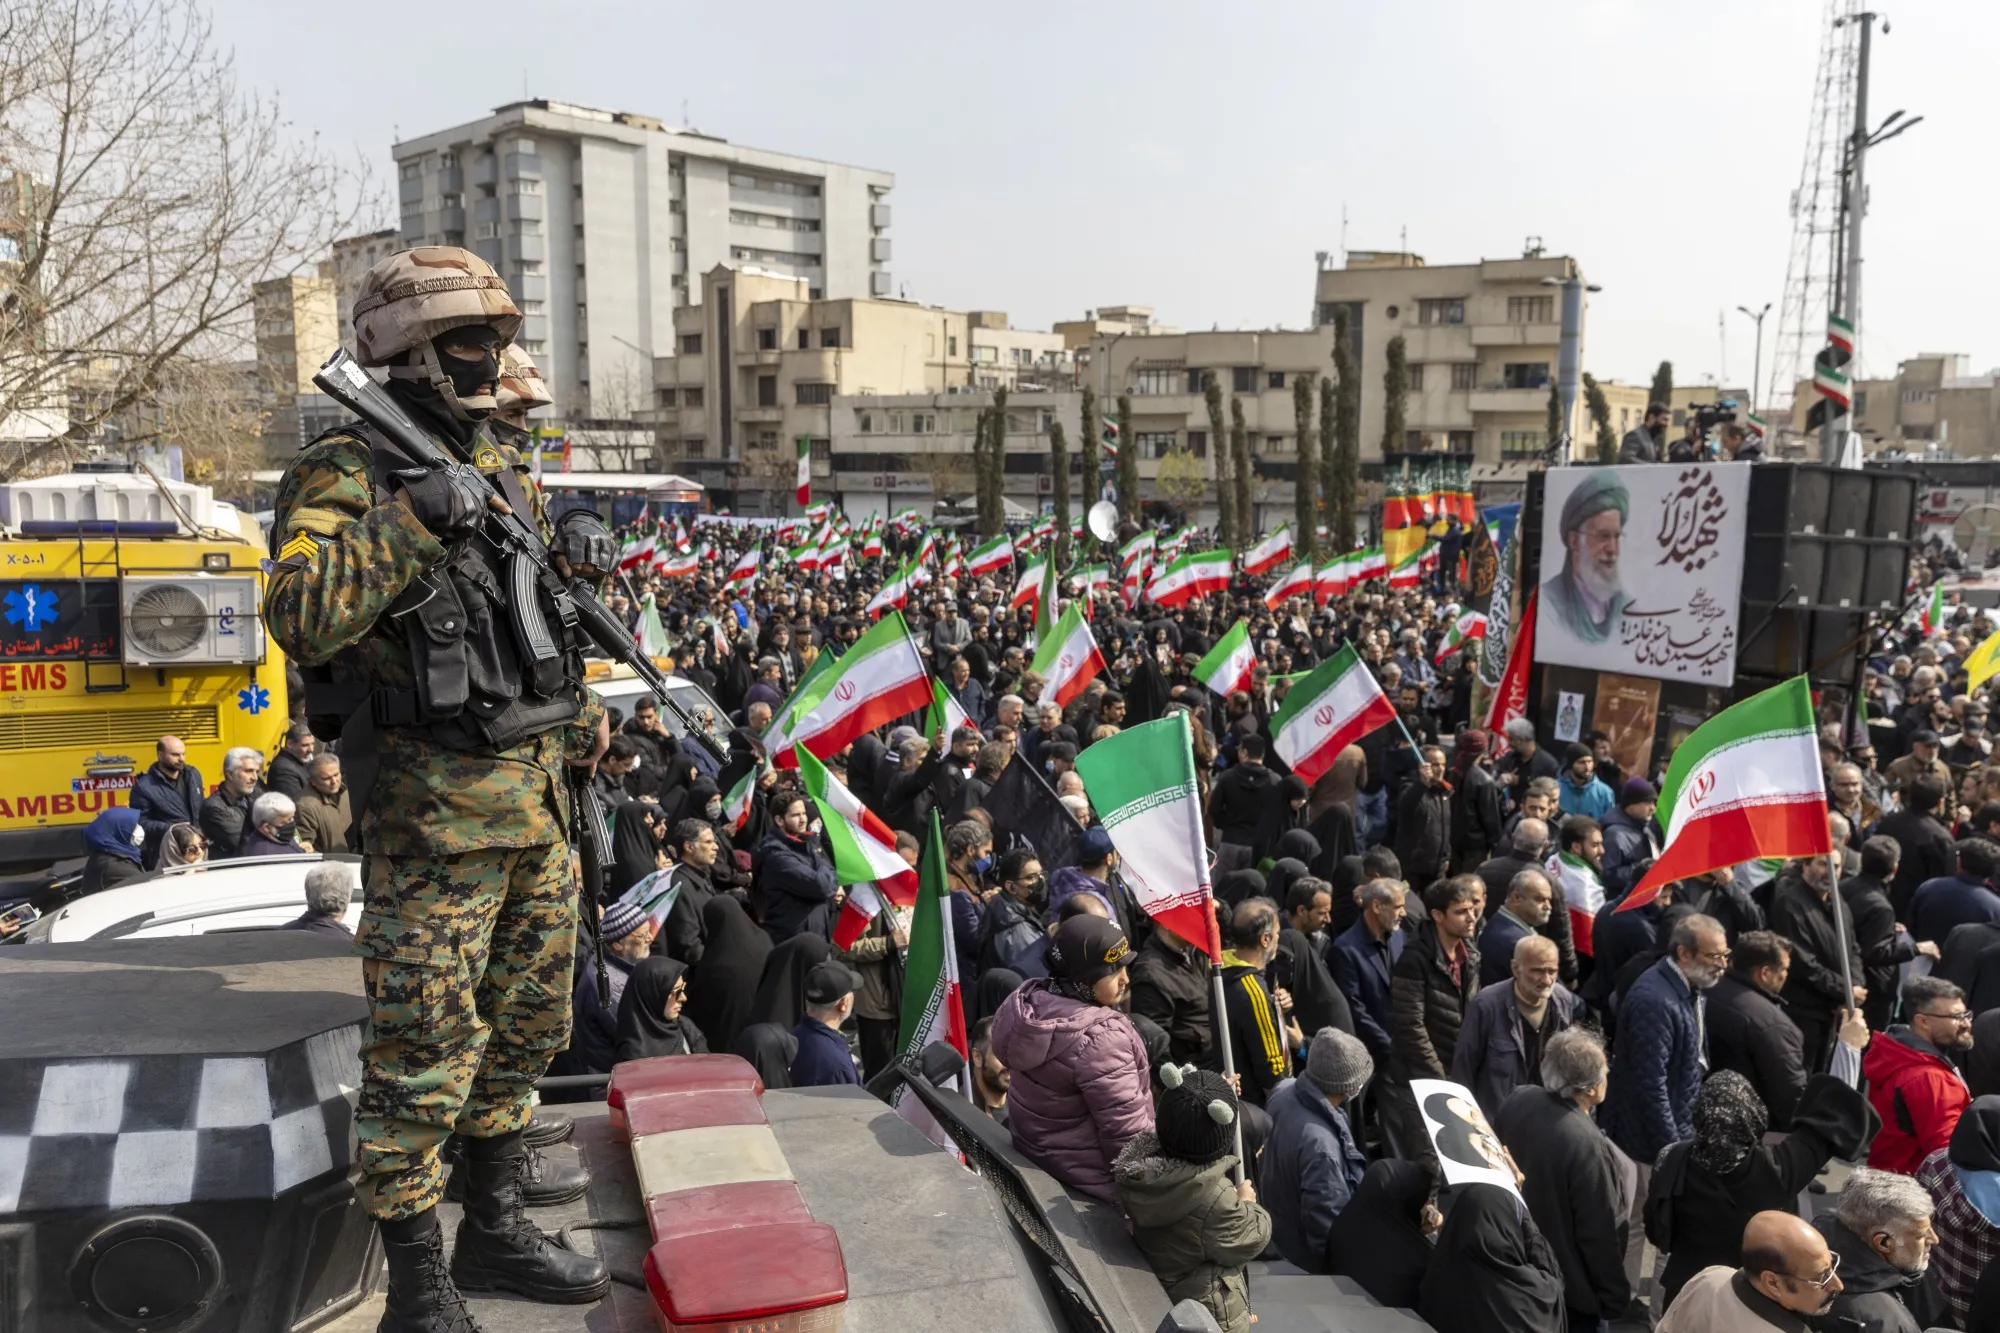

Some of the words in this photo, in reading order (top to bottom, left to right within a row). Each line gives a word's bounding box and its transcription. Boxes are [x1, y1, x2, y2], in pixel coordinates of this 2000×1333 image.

[5, 637, 41, 657] استان
[0, 663, 67, 692] EMS
[0, 788, 130, 819] AMBUL
